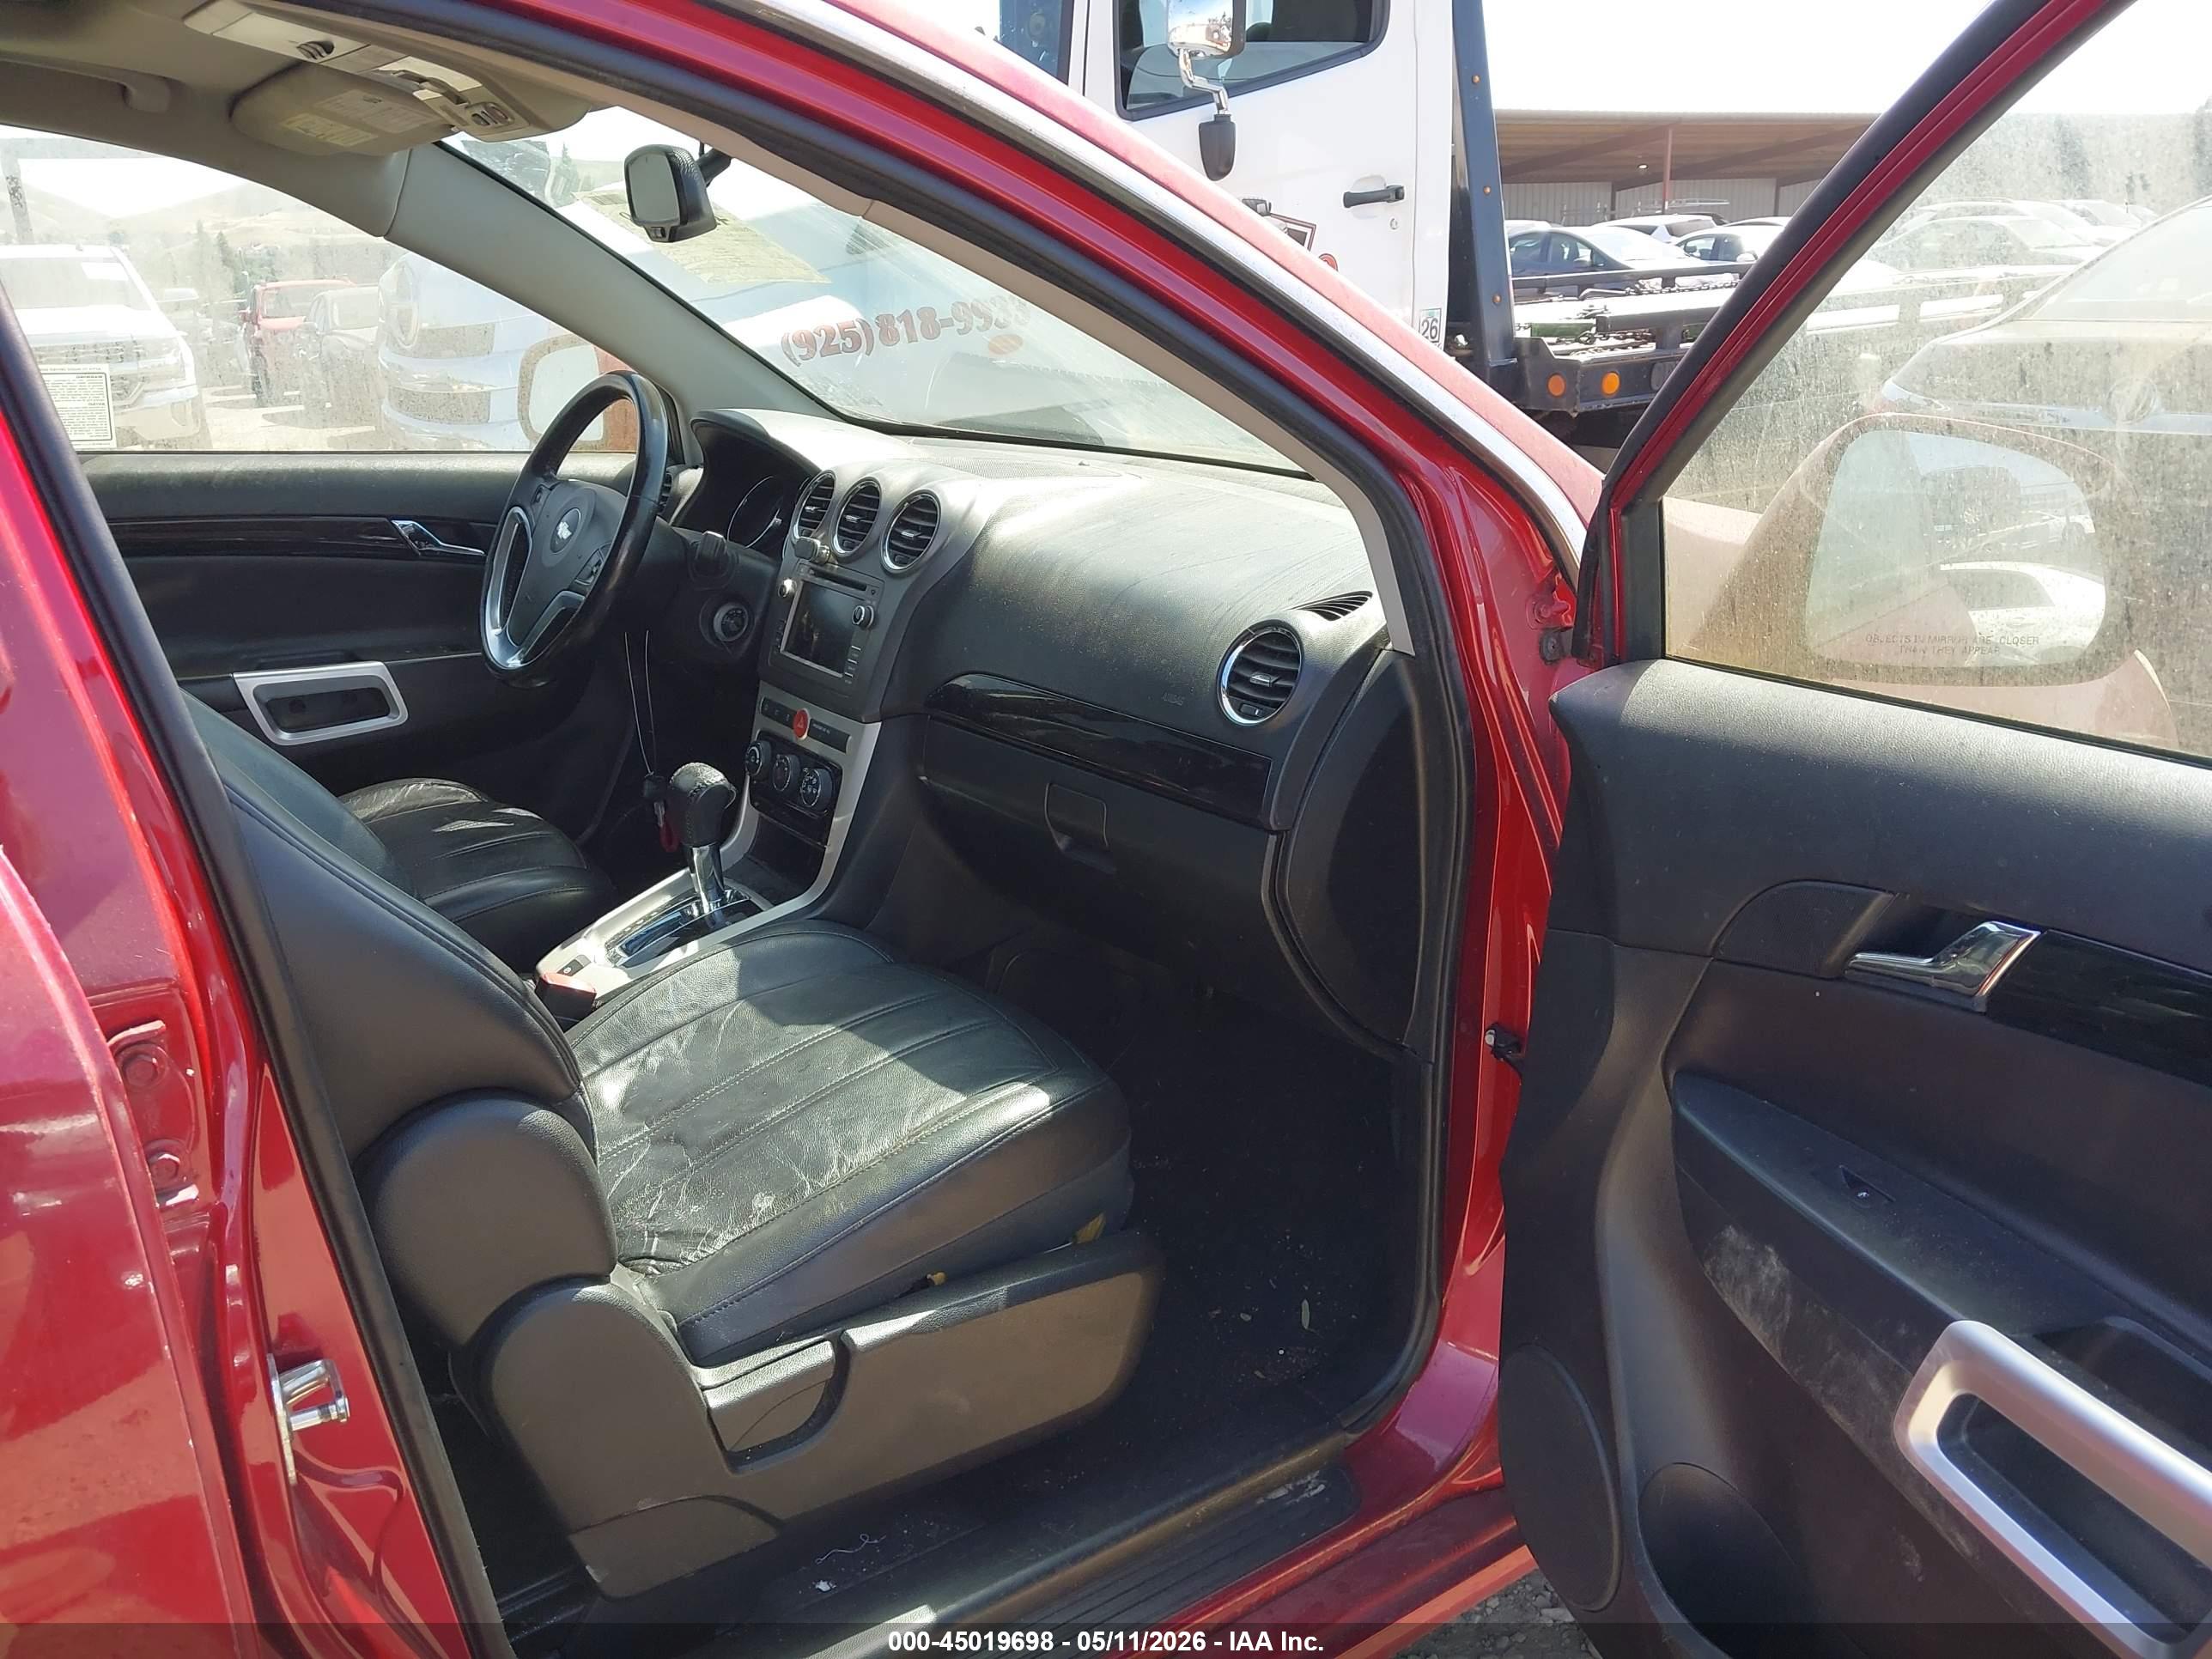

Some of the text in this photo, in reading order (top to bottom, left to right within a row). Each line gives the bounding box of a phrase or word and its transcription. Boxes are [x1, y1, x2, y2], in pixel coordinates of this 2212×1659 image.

[1421, 316, 1439, 340] 26
[781, 318, 874, 368] (925)
[1865, 633, 2039, 646] OBJECTS IN MIRROR ARE CLOSER
[1899, 645, 2000, 655] THAN THEY APPEAR
